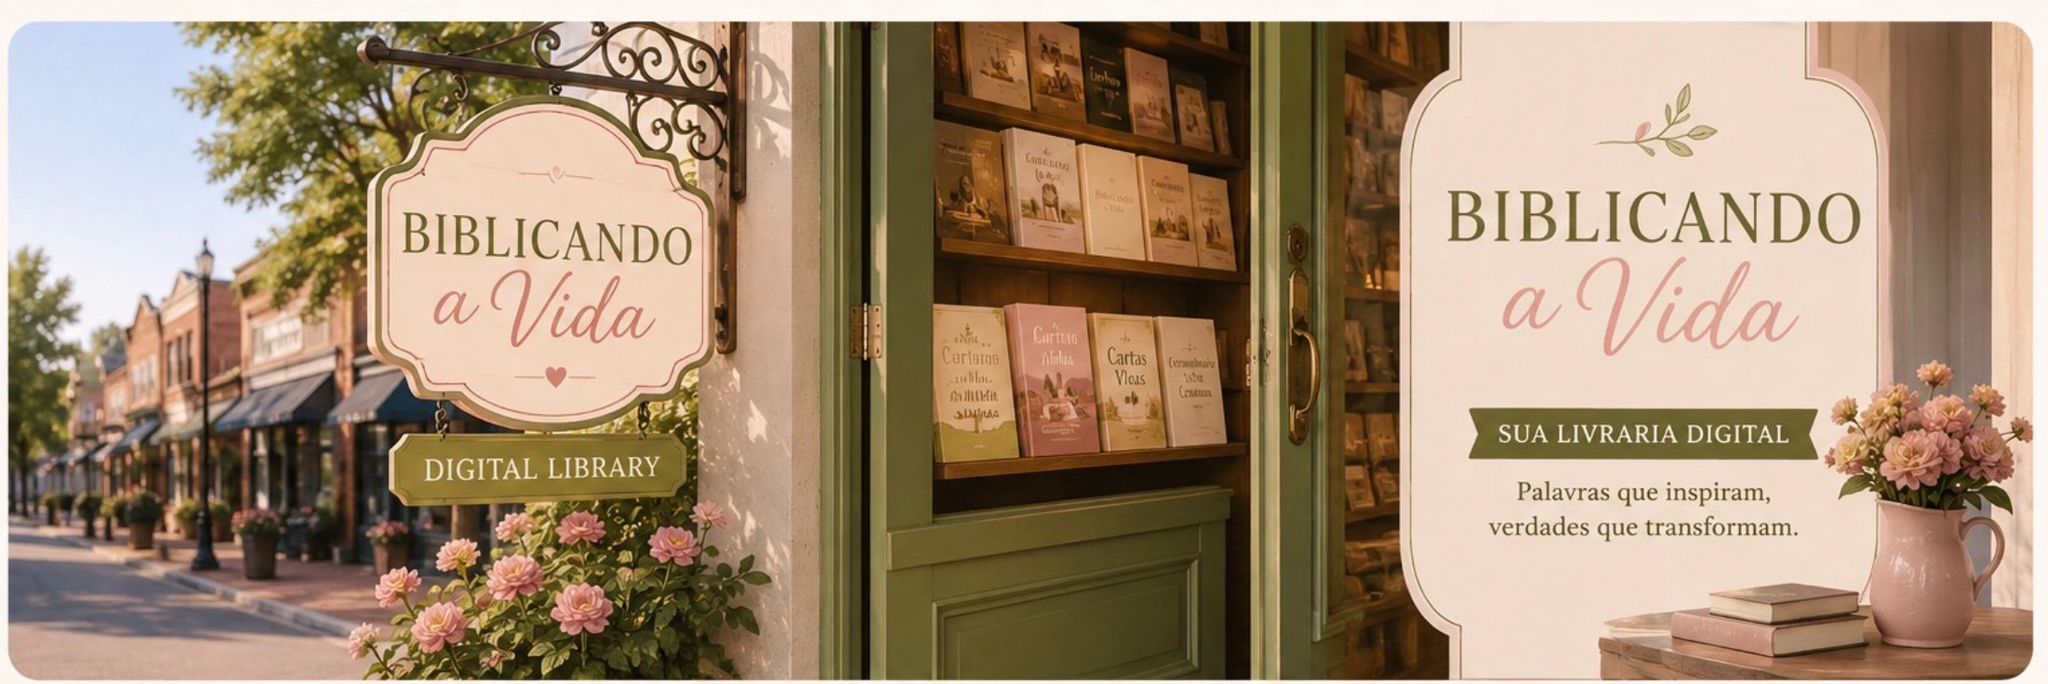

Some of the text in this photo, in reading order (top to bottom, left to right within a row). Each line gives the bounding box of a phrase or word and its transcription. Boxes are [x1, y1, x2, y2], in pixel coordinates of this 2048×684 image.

[1447, 190, 1861, 245] BIBLICANDO
[402, 211, 692, 265] BIBLICANDO
[433, 268, 656, 348] a Vida
[1502, 256, 1799, 357] a Vida
[1107, 346, 1148, 366] Cartas
[1498, 423, 1790, 444] SUA LIVRARIA DIGITAL
[424, 456, 661, 482] DIGITAL LIBRARY
[1517, 480, 1771, 508] Palavras que inspiram,
[1488, 514, 1799, 542] verdades que transformam.
